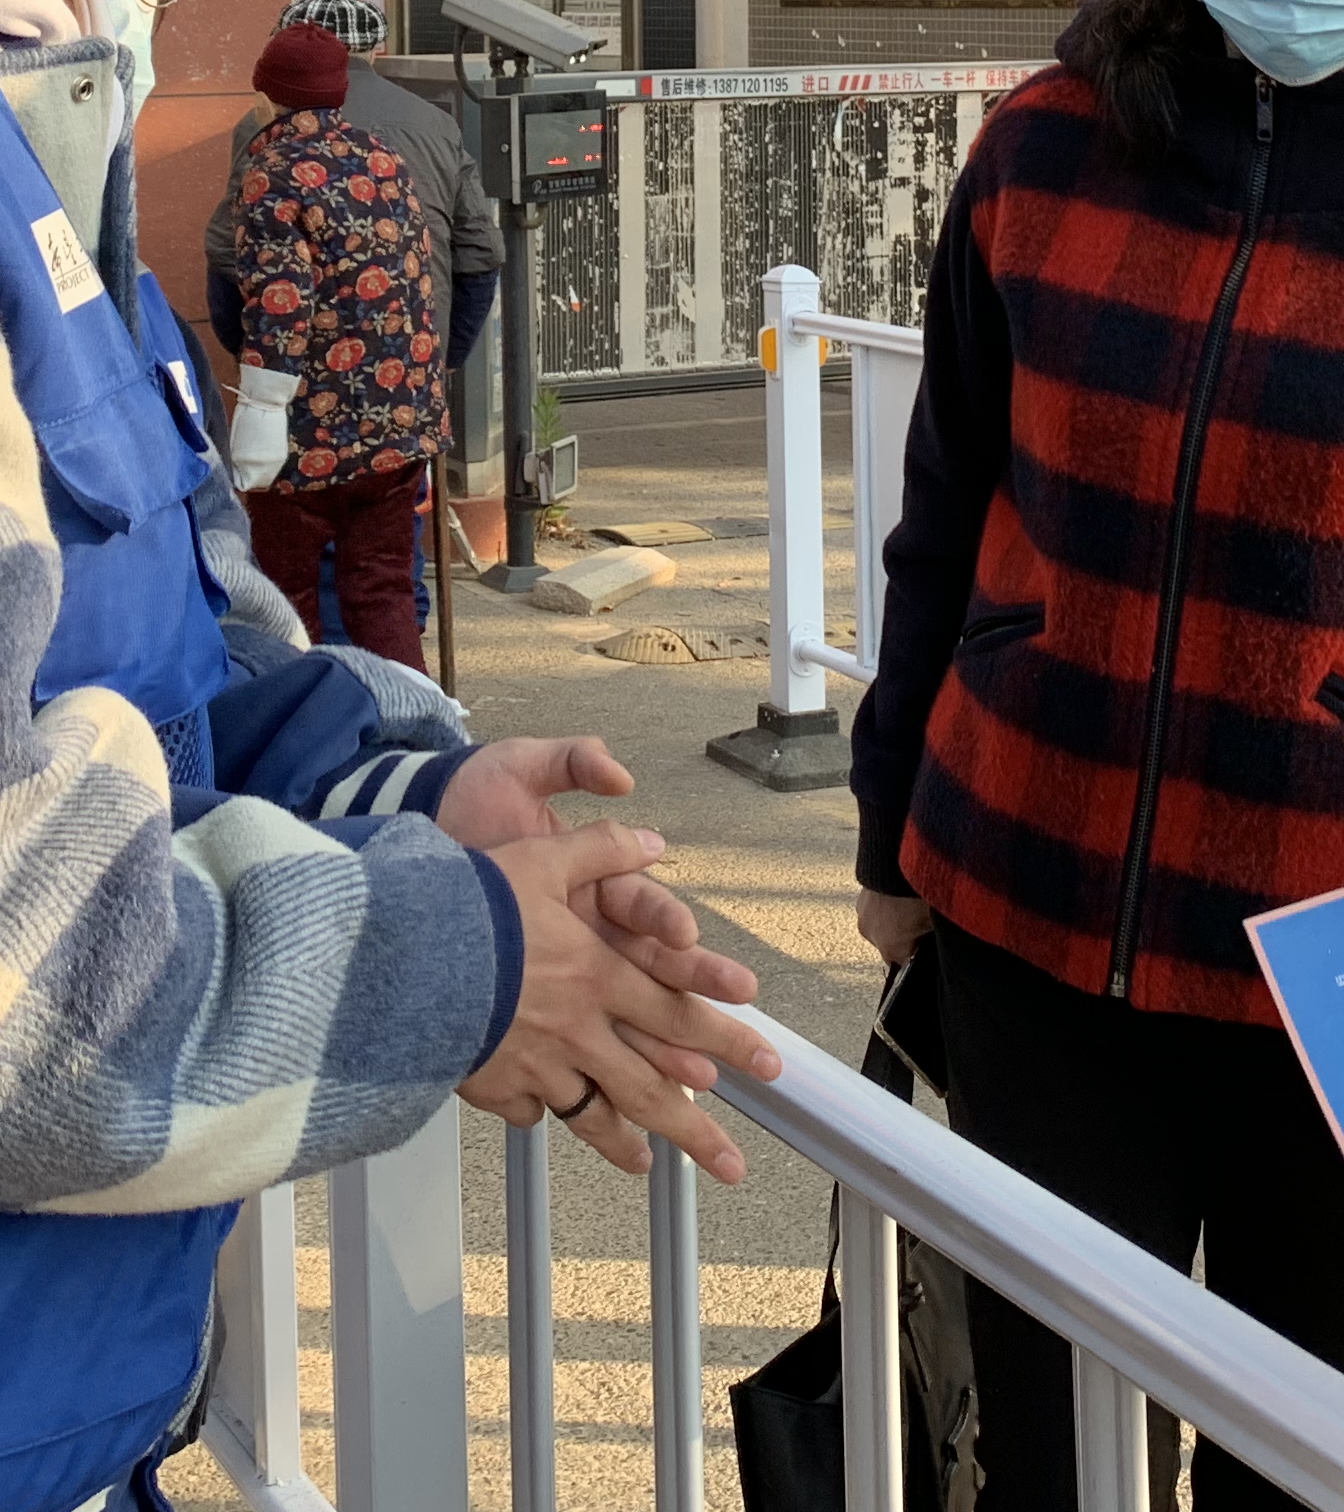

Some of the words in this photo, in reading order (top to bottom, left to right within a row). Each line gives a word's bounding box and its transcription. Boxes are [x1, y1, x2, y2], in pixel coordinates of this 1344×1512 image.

[801, 75, 829, 93] 进口
[878, 73, 924, 90] 禁止行人
[931, 70, 975, 87] 一车一杆
[57, 267, 90, 294] PROJECT
